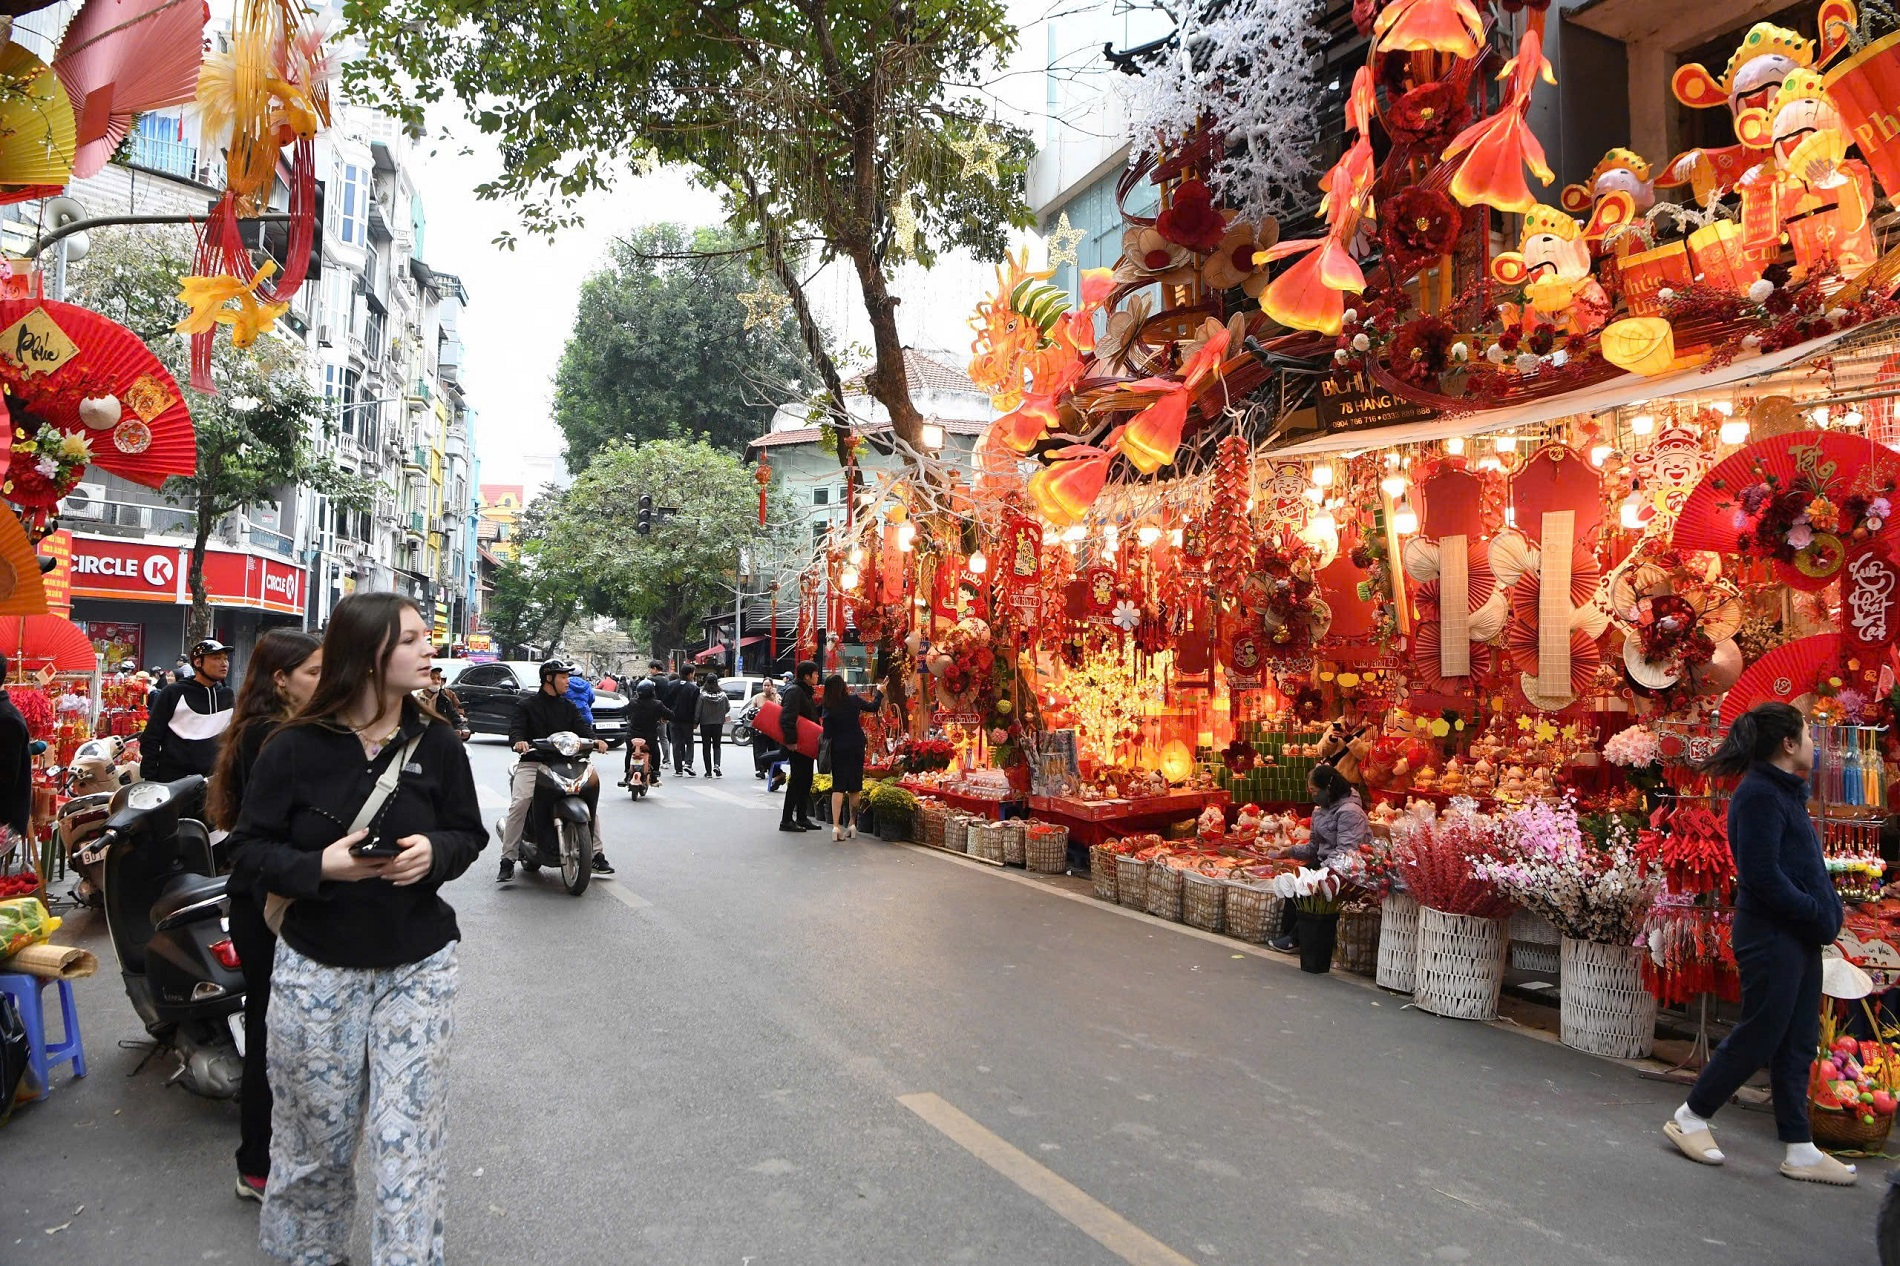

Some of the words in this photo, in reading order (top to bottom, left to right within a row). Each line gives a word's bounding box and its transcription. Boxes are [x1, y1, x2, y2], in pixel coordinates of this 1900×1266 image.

[1340, 401, 1353, 414] 78
[1354, 395, 1391, 412] HÀNG
[266, 573, 286, 593] CIRCLE
[959, 569, 983, 587] Xuân
